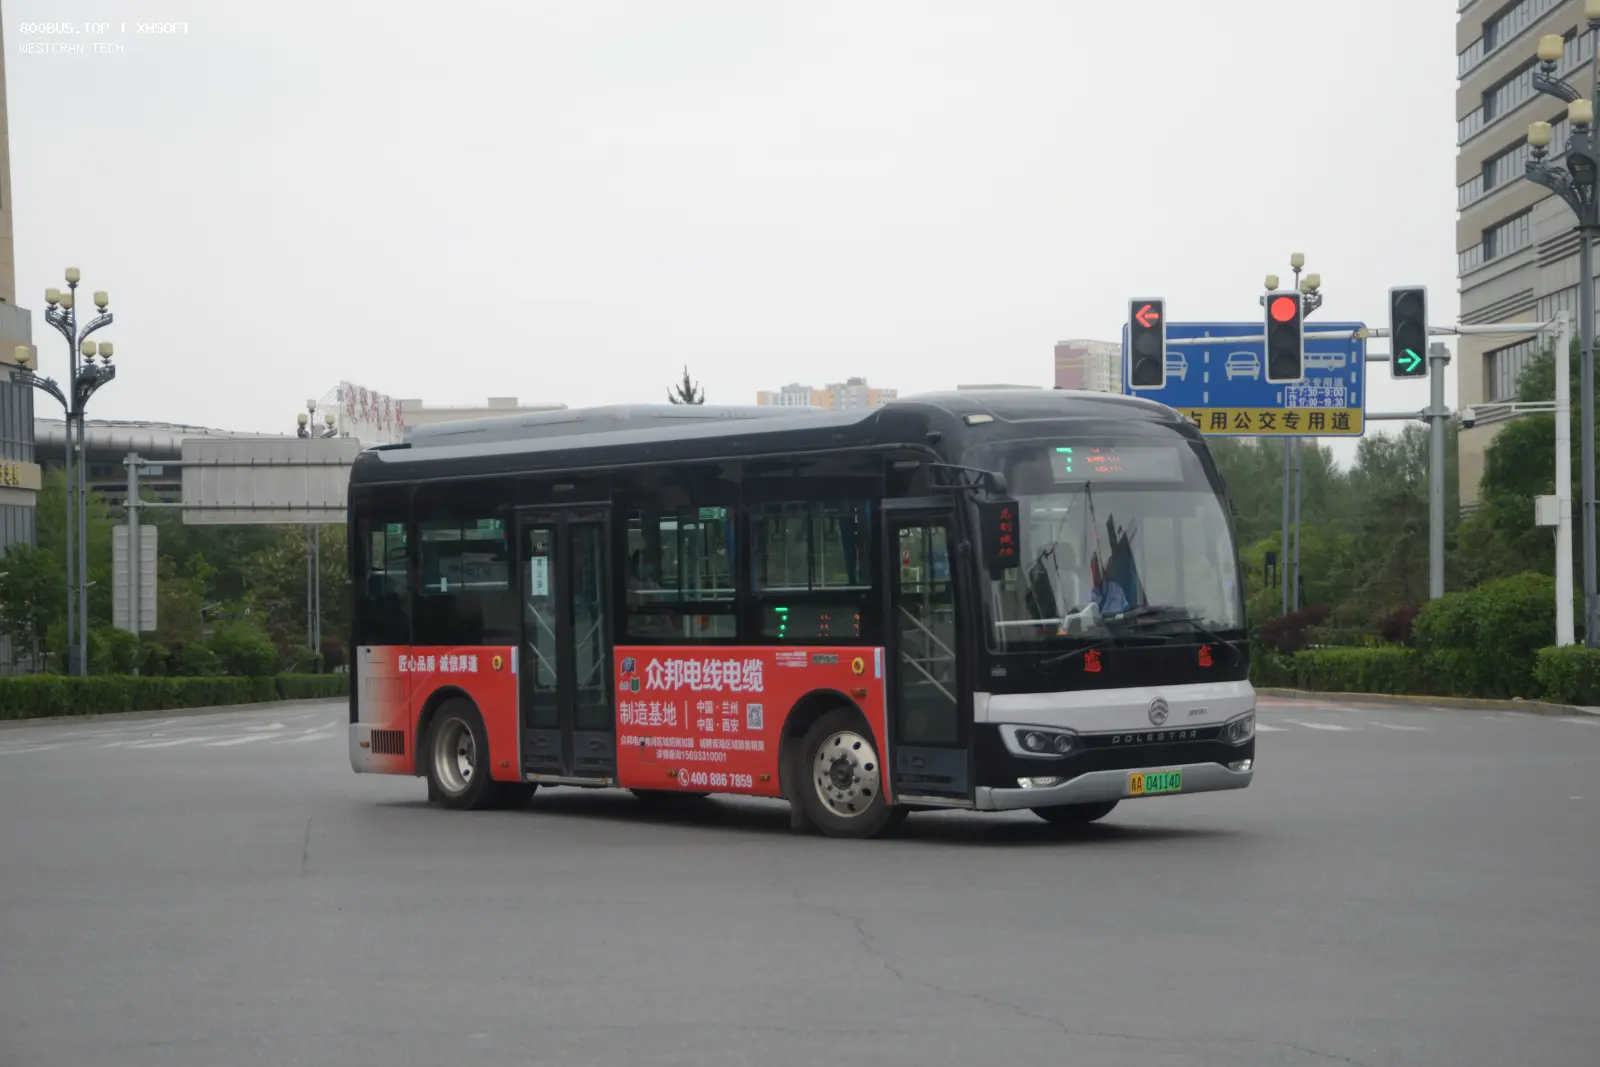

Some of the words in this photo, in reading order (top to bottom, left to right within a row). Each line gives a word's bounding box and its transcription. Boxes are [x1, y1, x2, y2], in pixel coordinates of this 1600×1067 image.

[398, 655, 435, 672] 匠心品质
[645, 658, 764, 692] 众邦电线电缆
[619, 701, 677, 726] 制造基地
[691, 771, 707, 786] 400
[710, 772, 727, 787] 886
[729, 773, 753, 788] 7859
